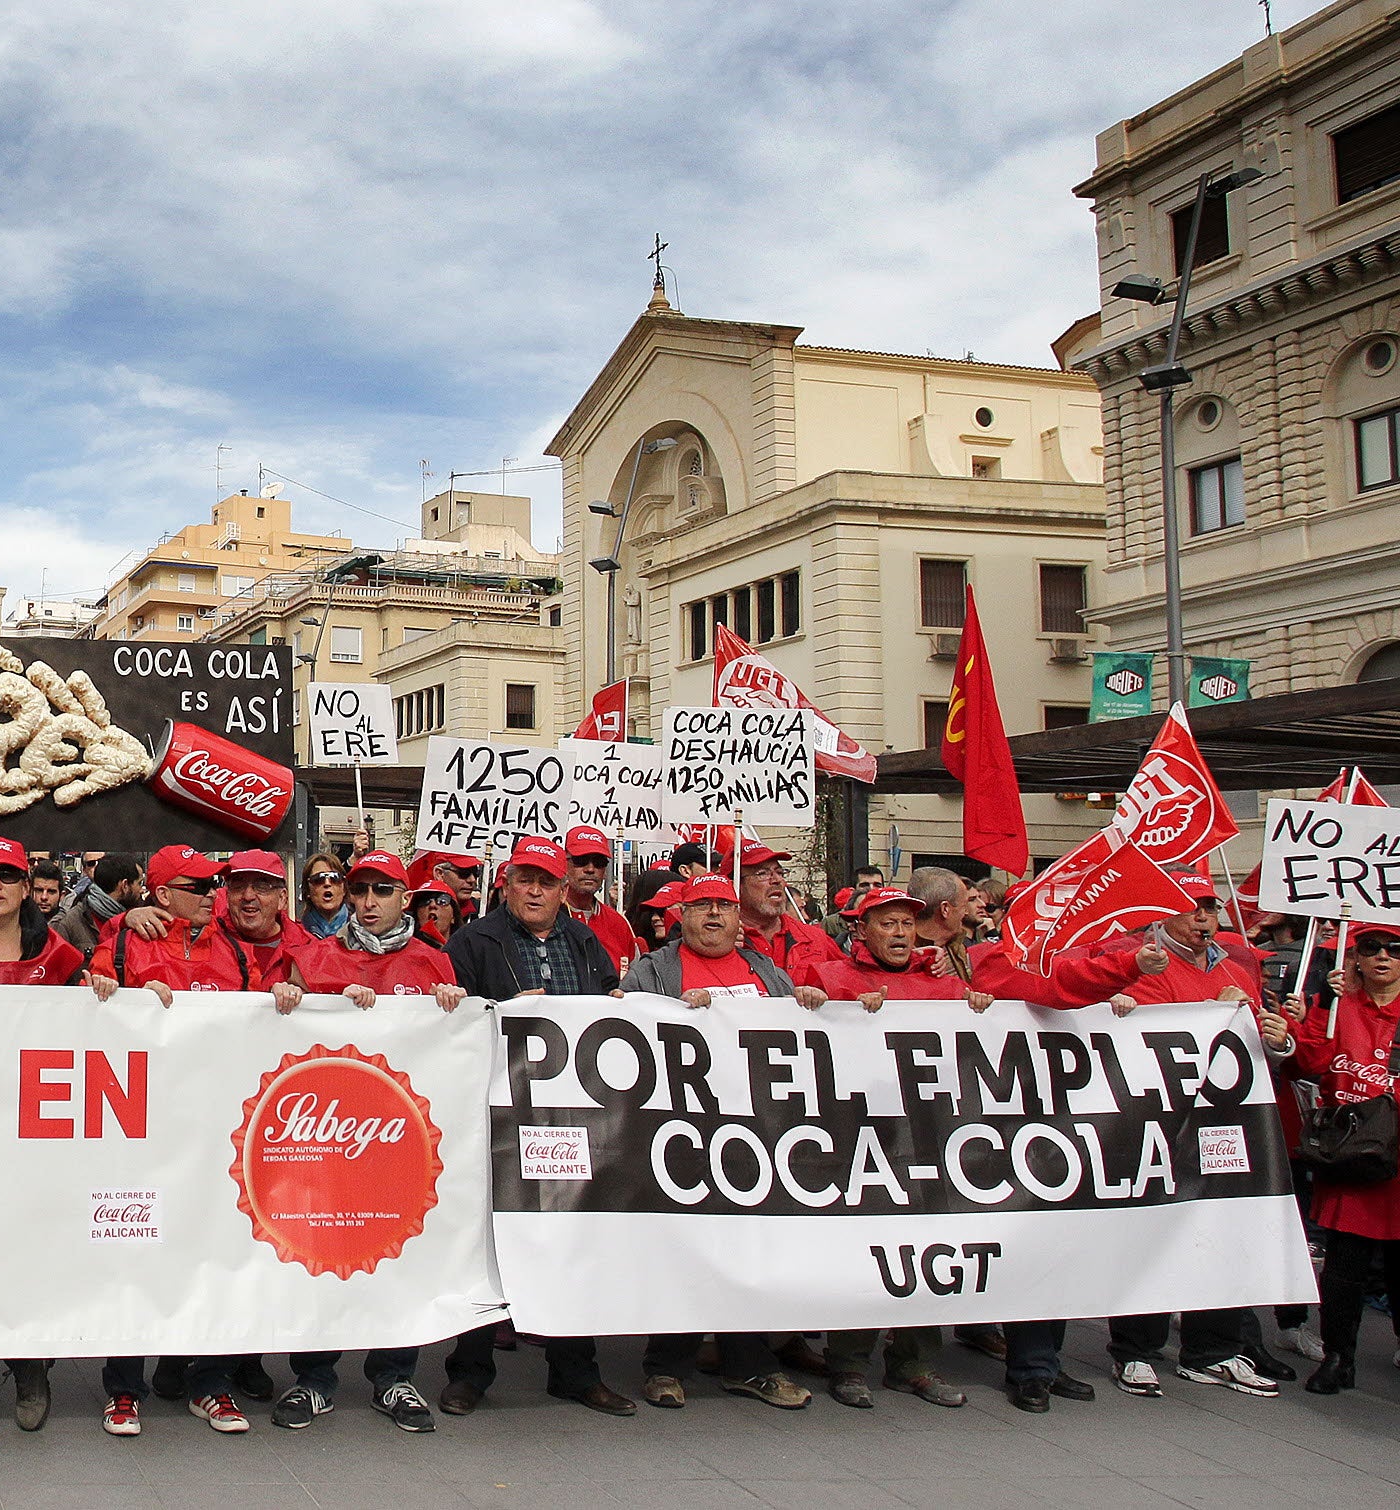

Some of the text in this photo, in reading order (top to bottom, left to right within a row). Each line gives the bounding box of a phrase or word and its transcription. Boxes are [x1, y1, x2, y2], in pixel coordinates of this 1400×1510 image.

[113, 646, 280, 680] COCA COLA
[728, 662, 790, 705] UGT
[1106, 669, 1143, 695] JOGUETS
[1200, 675, 1237, 700] JOGUETS
[181, 690, 210, 711] ES
[225, 687, 283, 734] ASÍ
[314, 689, 360, 718] NO
[355, 714, 374, 733] AL
[673, 710, 732, 736] COCA
[741, 710, 807, 743] COLA
[321, 729, 389, 757] ERE
[603, 744, 622, 761] 1
[174, 749, 288, 817] Coca-Cola
[445, 746, 564, 795] 1250
[666, 766, 724, 794] 1250
[603, 786, 618, 805] 1
[1271, 808, 1343, 849] NO
[502, 1017, 1253, 1117] POR EL EMPLEO
[18, 1049, 149, 1139] EN
[1353, 1082, 1367, 1092] NI
[264, 1093, 406, 1160] Sabega
[525, 1142, 580, 1160] Coca-Cola
[651, 1119, 1176, 1207] COCA-COLA
[536, 1165, 587, 1174] ALICANTE
[93, 1203, 154, 1223] Coca-Cola
[91, 1228, 158, 1238] EN ALICANTE
[870, 1243, 1002, 1299] UGT
